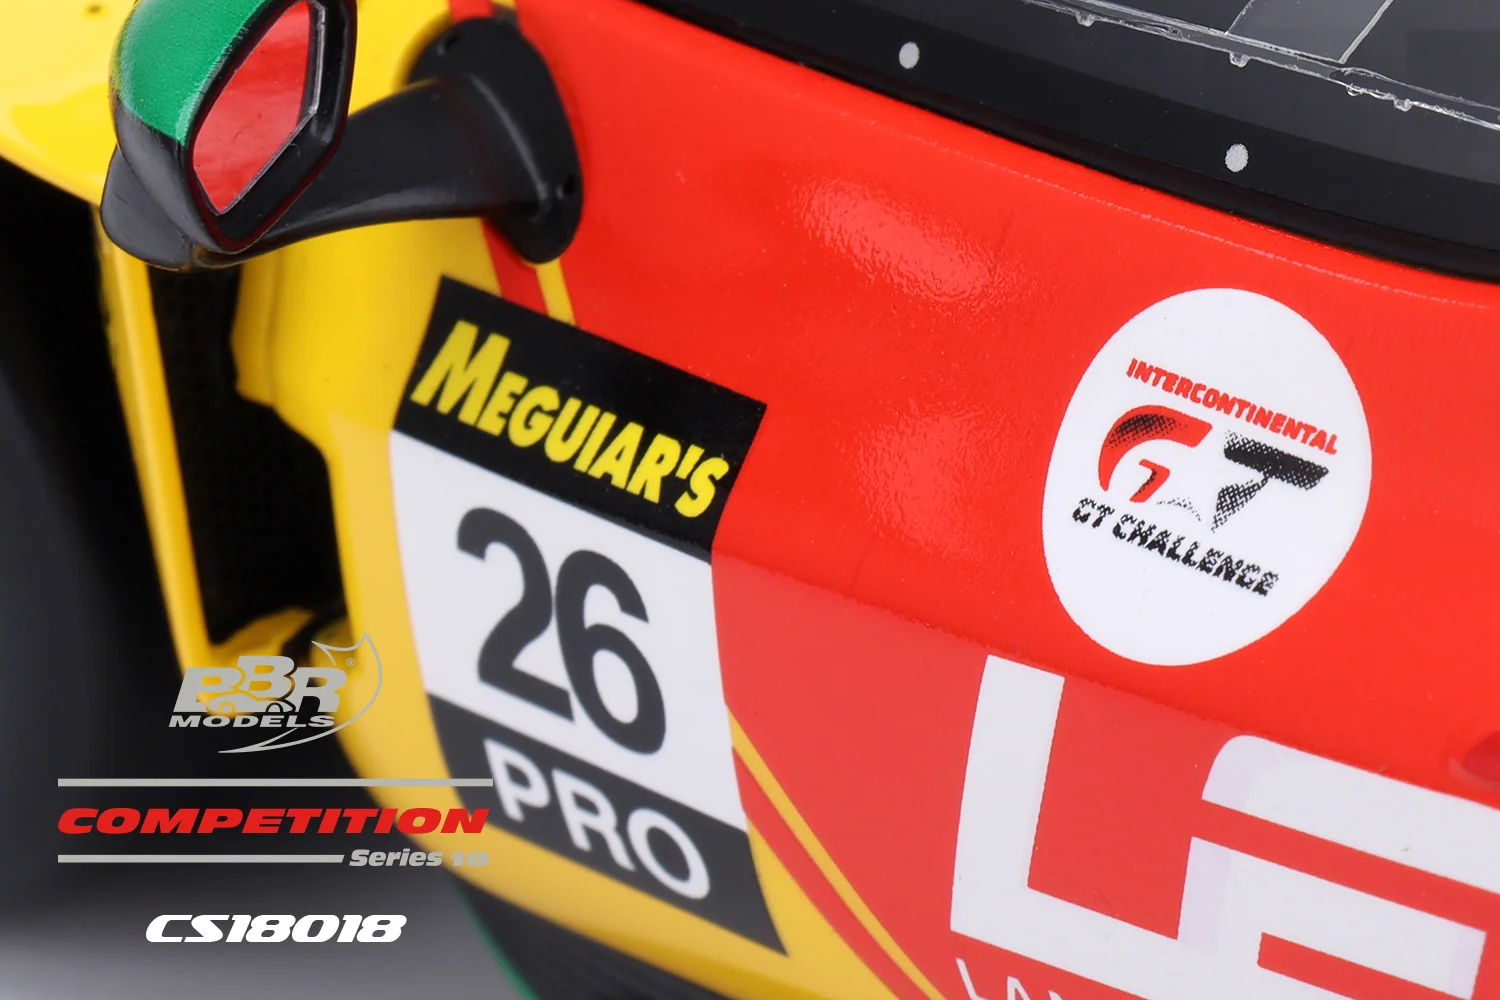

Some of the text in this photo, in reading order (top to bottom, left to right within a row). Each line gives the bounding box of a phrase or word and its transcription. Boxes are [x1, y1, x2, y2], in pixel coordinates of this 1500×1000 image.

[1125, 357, 1339, 456] INTERCONTINENTAL
[1112, 512, 1280, 598] CHALLENGE
[455, 505, 668, 758] 26
[483, 737, 711, 900] PRO
